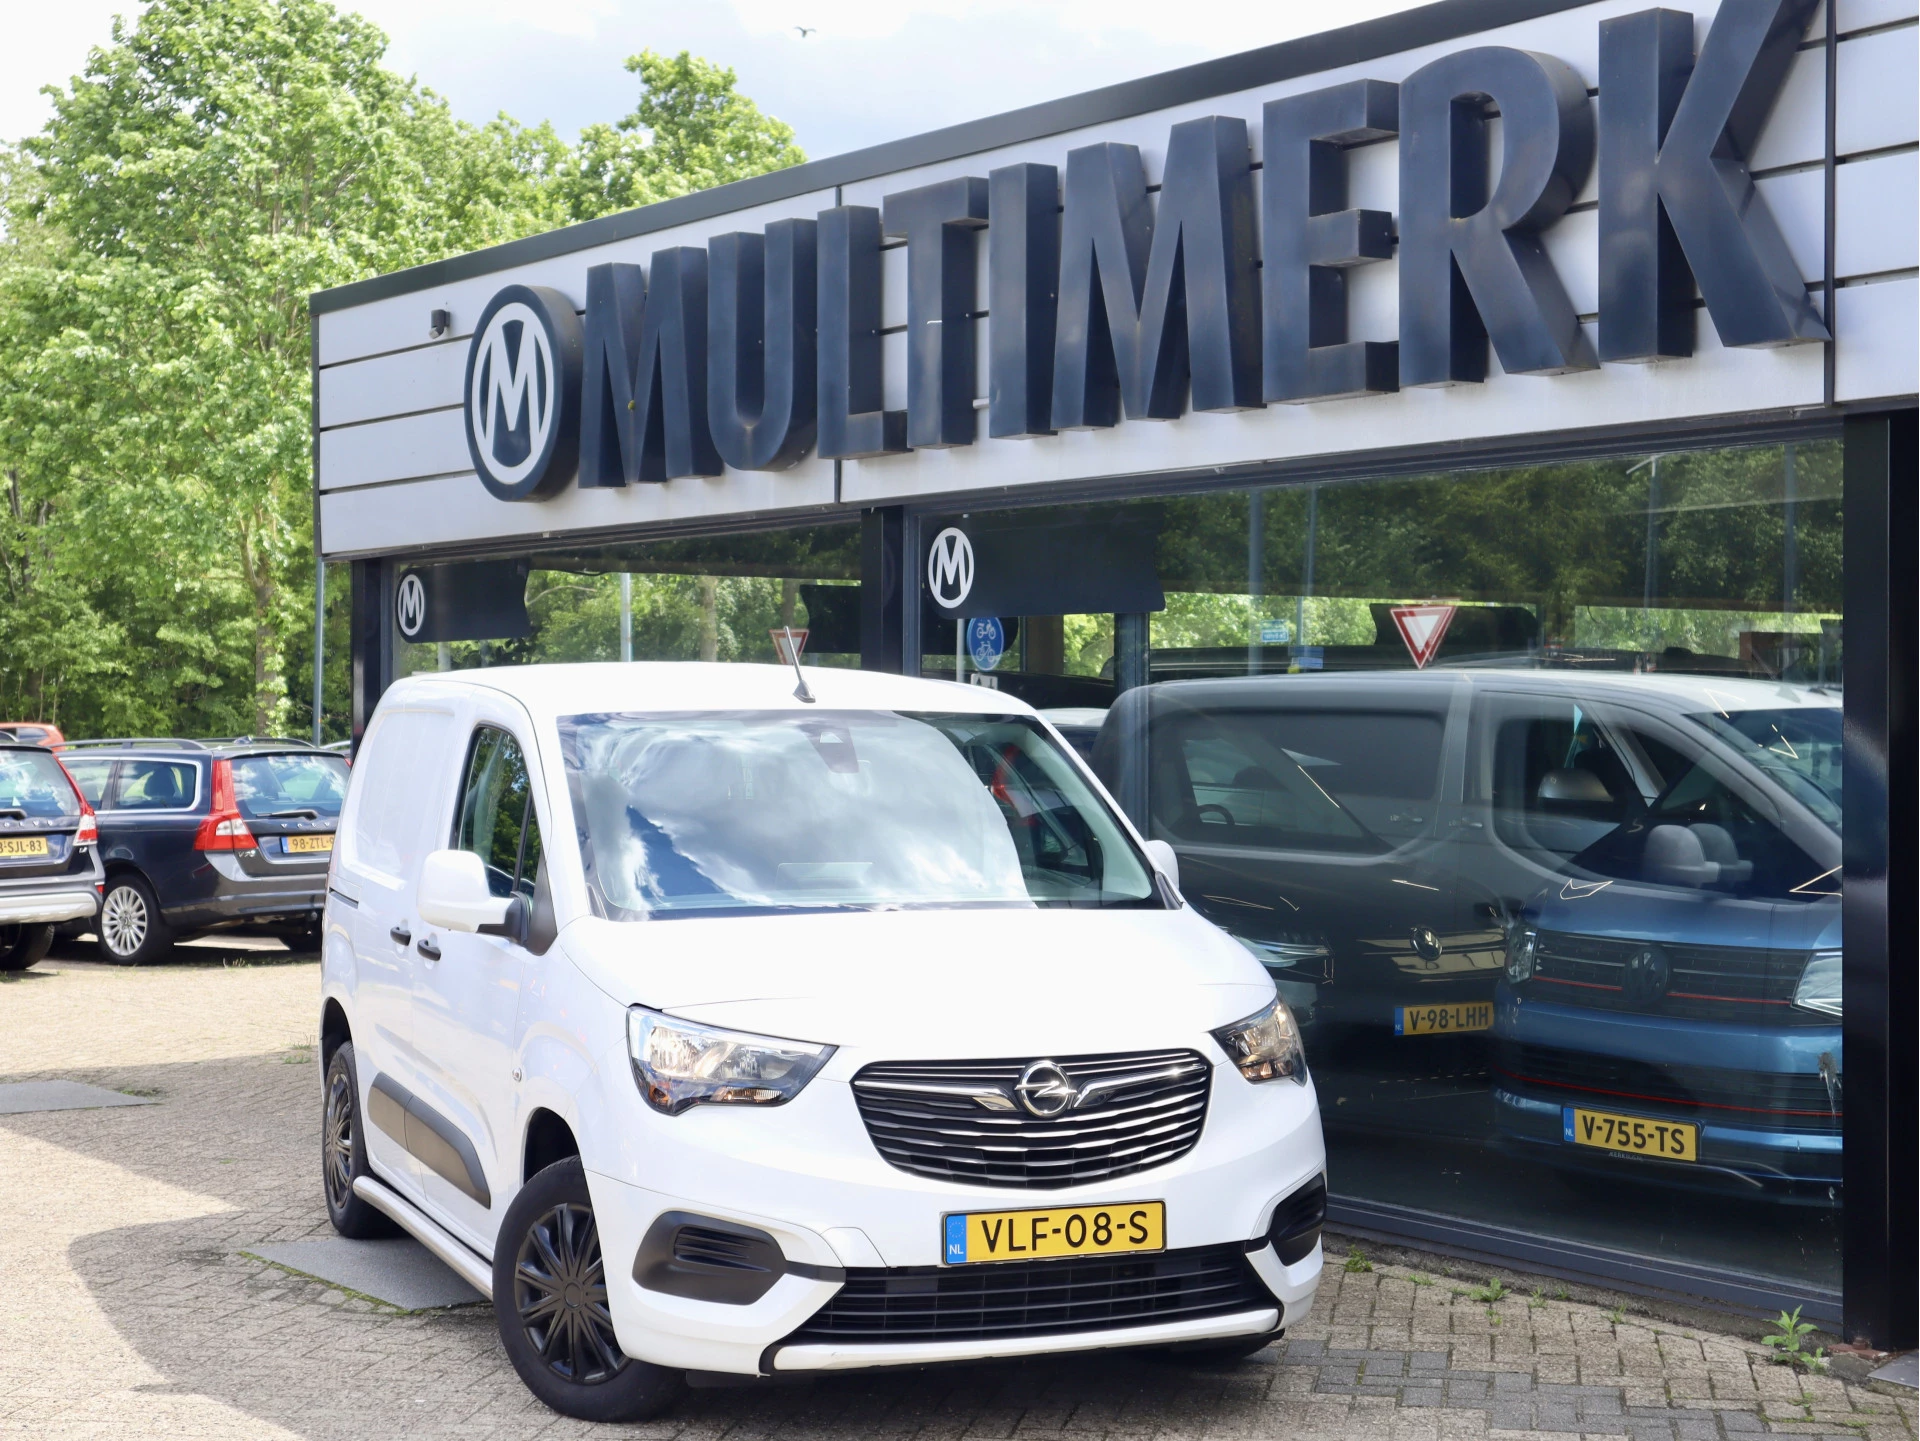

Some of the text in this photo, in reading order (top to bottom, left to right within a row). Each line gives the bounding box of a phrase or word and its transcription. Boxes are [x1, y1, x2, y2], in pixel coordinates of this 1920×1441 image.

[578, 0, 1831, 490] MULTIMERK
[1409, 1005, 1489, 1032] V-98-LHH
[1565, 1114, 1686, 1155] NL V-755-TS
[949, 1210, 1149, 1255] NL VLF-08-S
